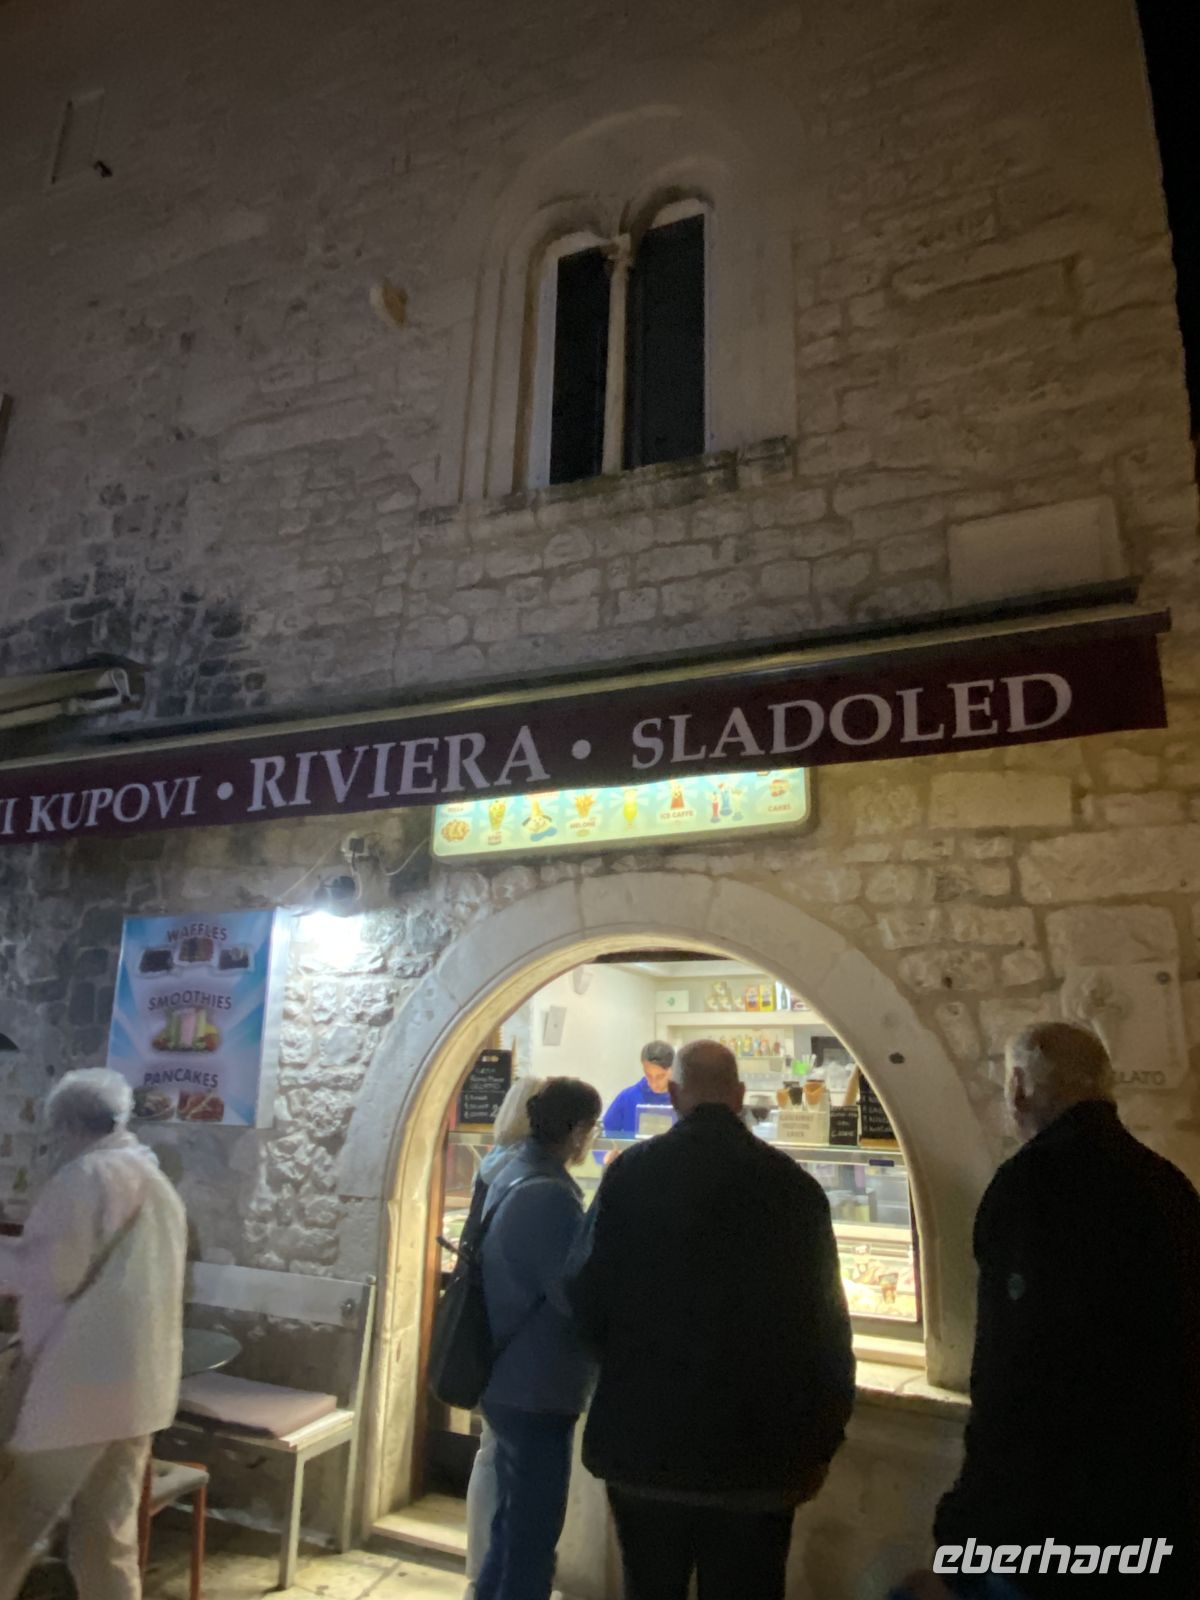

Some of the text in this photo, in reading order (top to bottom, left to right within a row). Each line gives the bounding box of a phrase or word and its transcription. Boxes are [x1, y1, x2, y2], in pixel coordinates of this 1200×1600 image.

[26, 775, 201, 834] KUPOVI
[247, 725, 551, 814] RIVIERA
[631, 672, 1072, 771] SLADOLED
[166, 922, 229, 943] WAFFLES
[147, 990, 232, 1011] SMOOTHIES
[143, 1067, 219, 1089] PANCAKES
